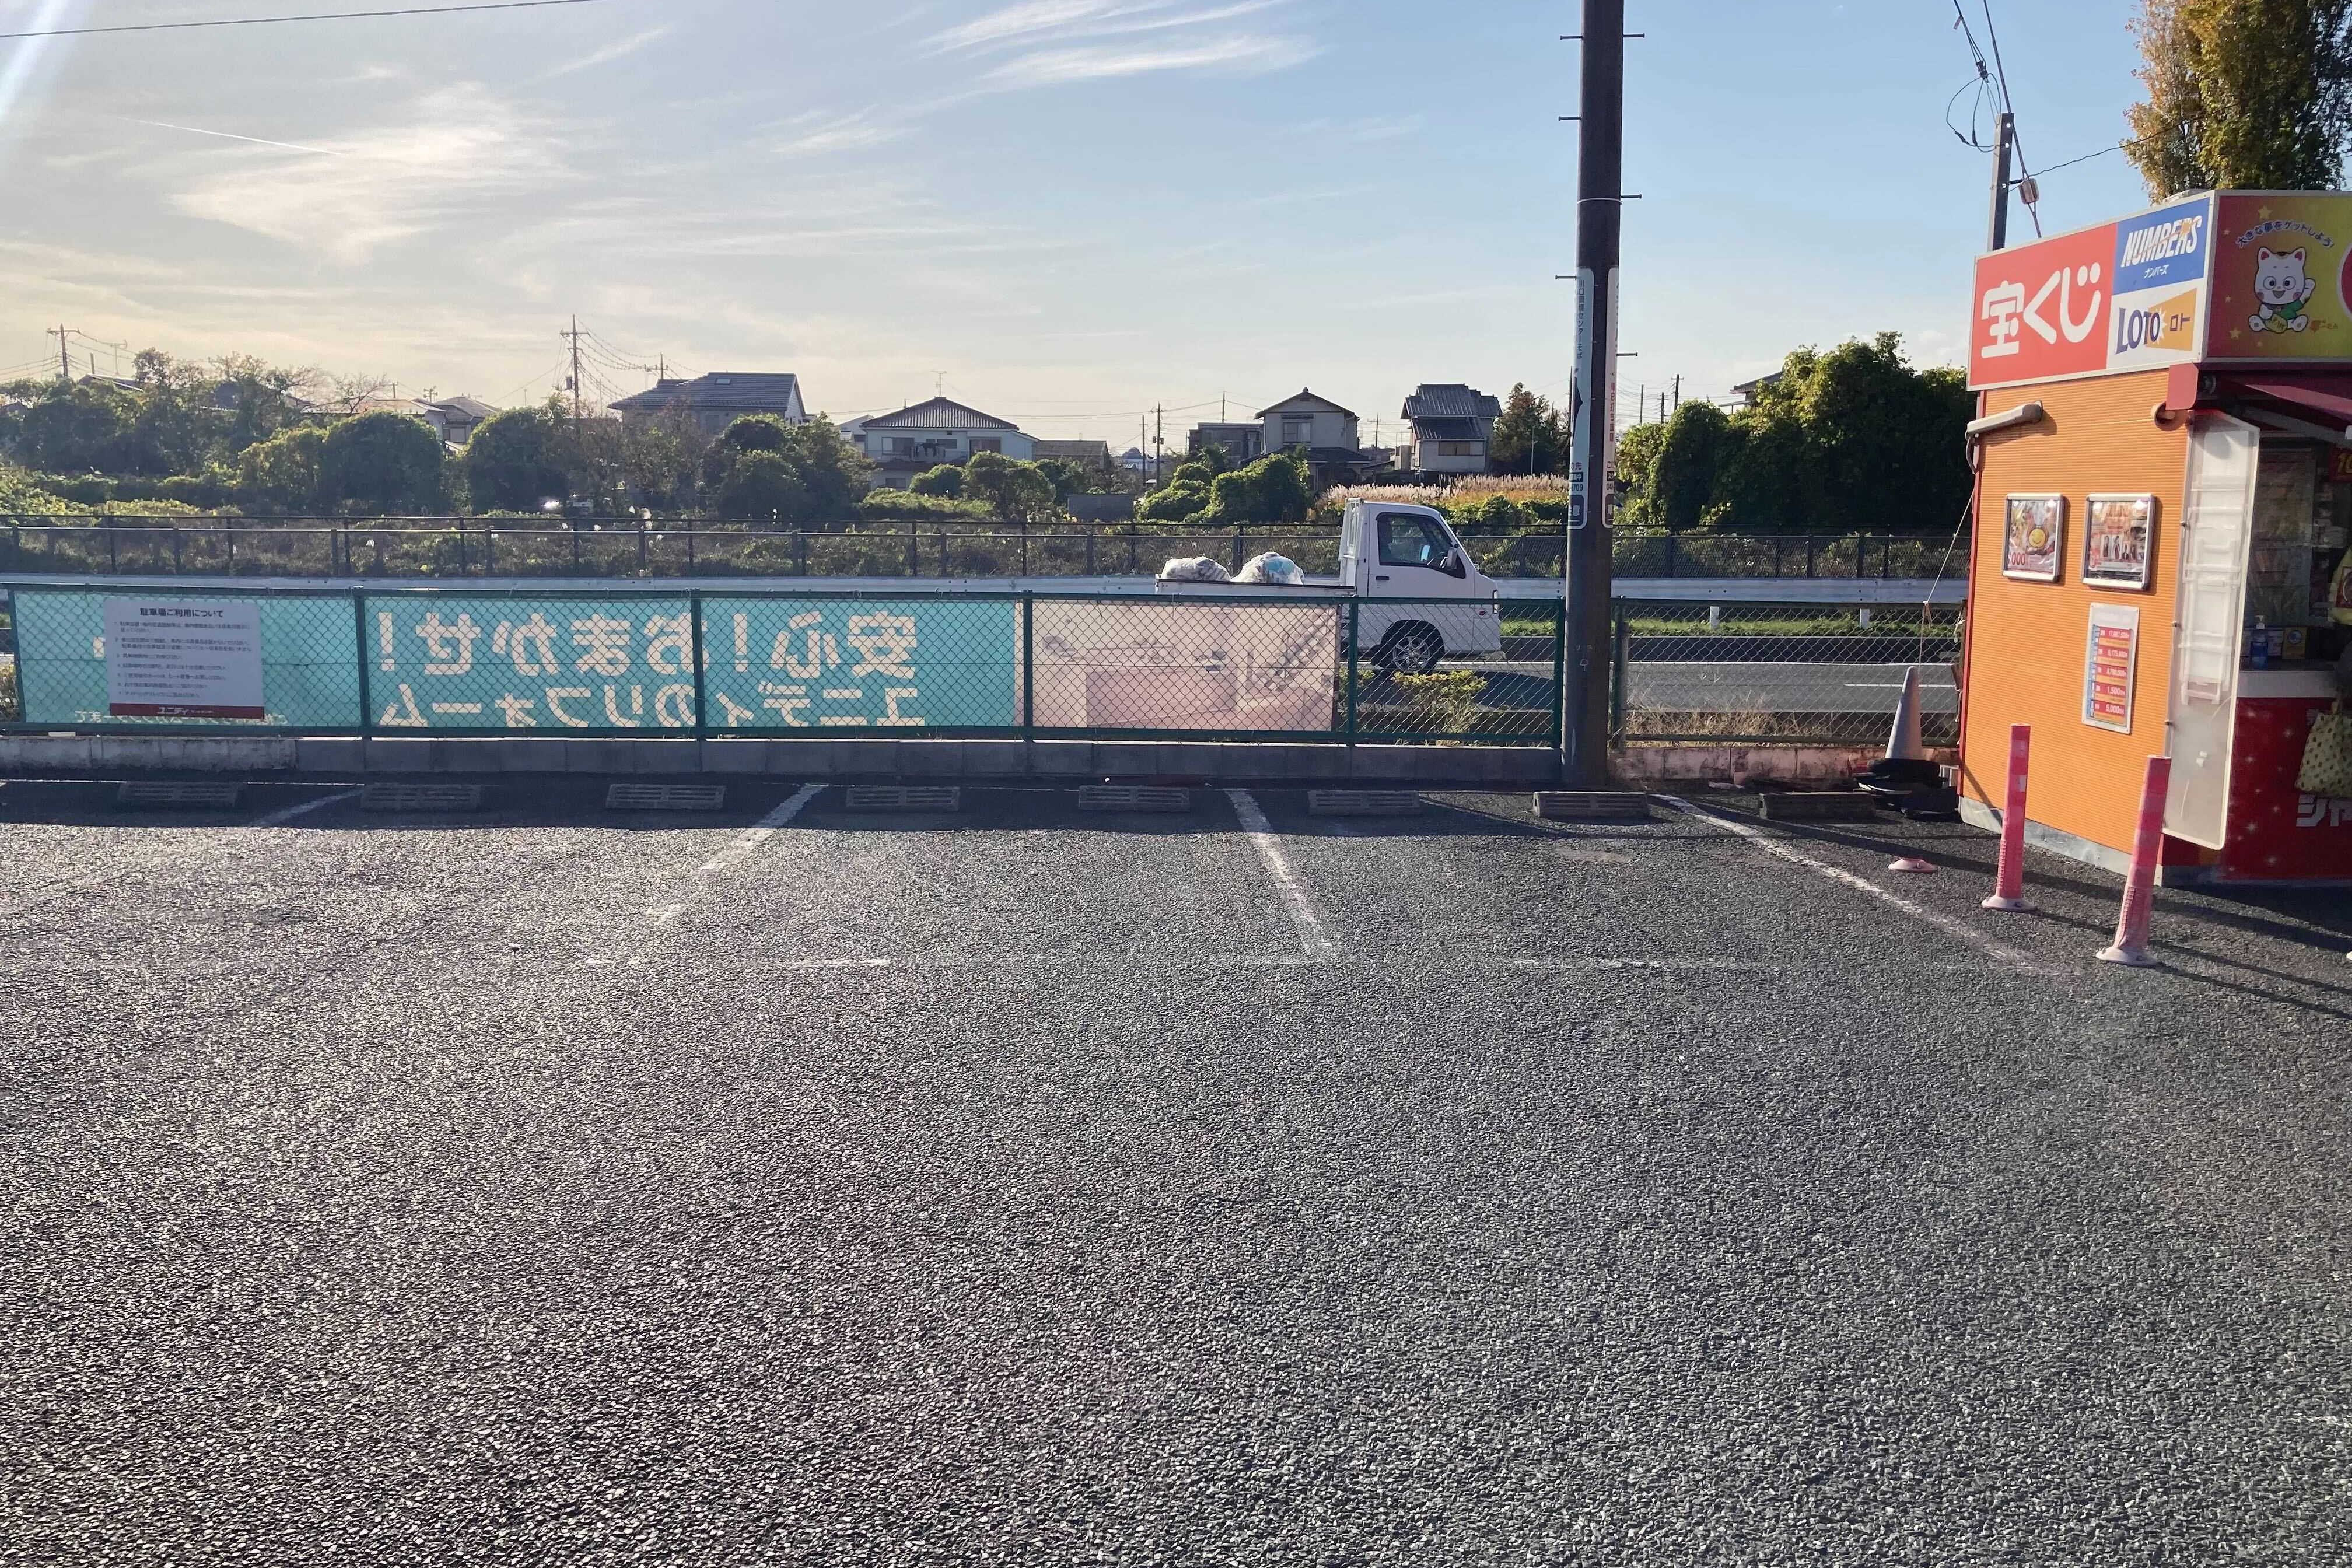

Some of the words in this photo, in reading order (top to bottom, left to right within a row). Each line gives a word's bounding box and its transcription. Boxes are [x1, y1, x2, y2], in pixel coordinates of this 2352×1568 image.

[2120, 215, 2202, 268] NUMBERS
[2144, 264, 2169, 279] ナンバーズ
[1981, 262, 2101, 359] 宝くじ
[2169, 312, 2190, 332] ロト
[2115, 307, 2160, 355] LOTO
[139, 607, 224, 618] 駐車場ご利用について
